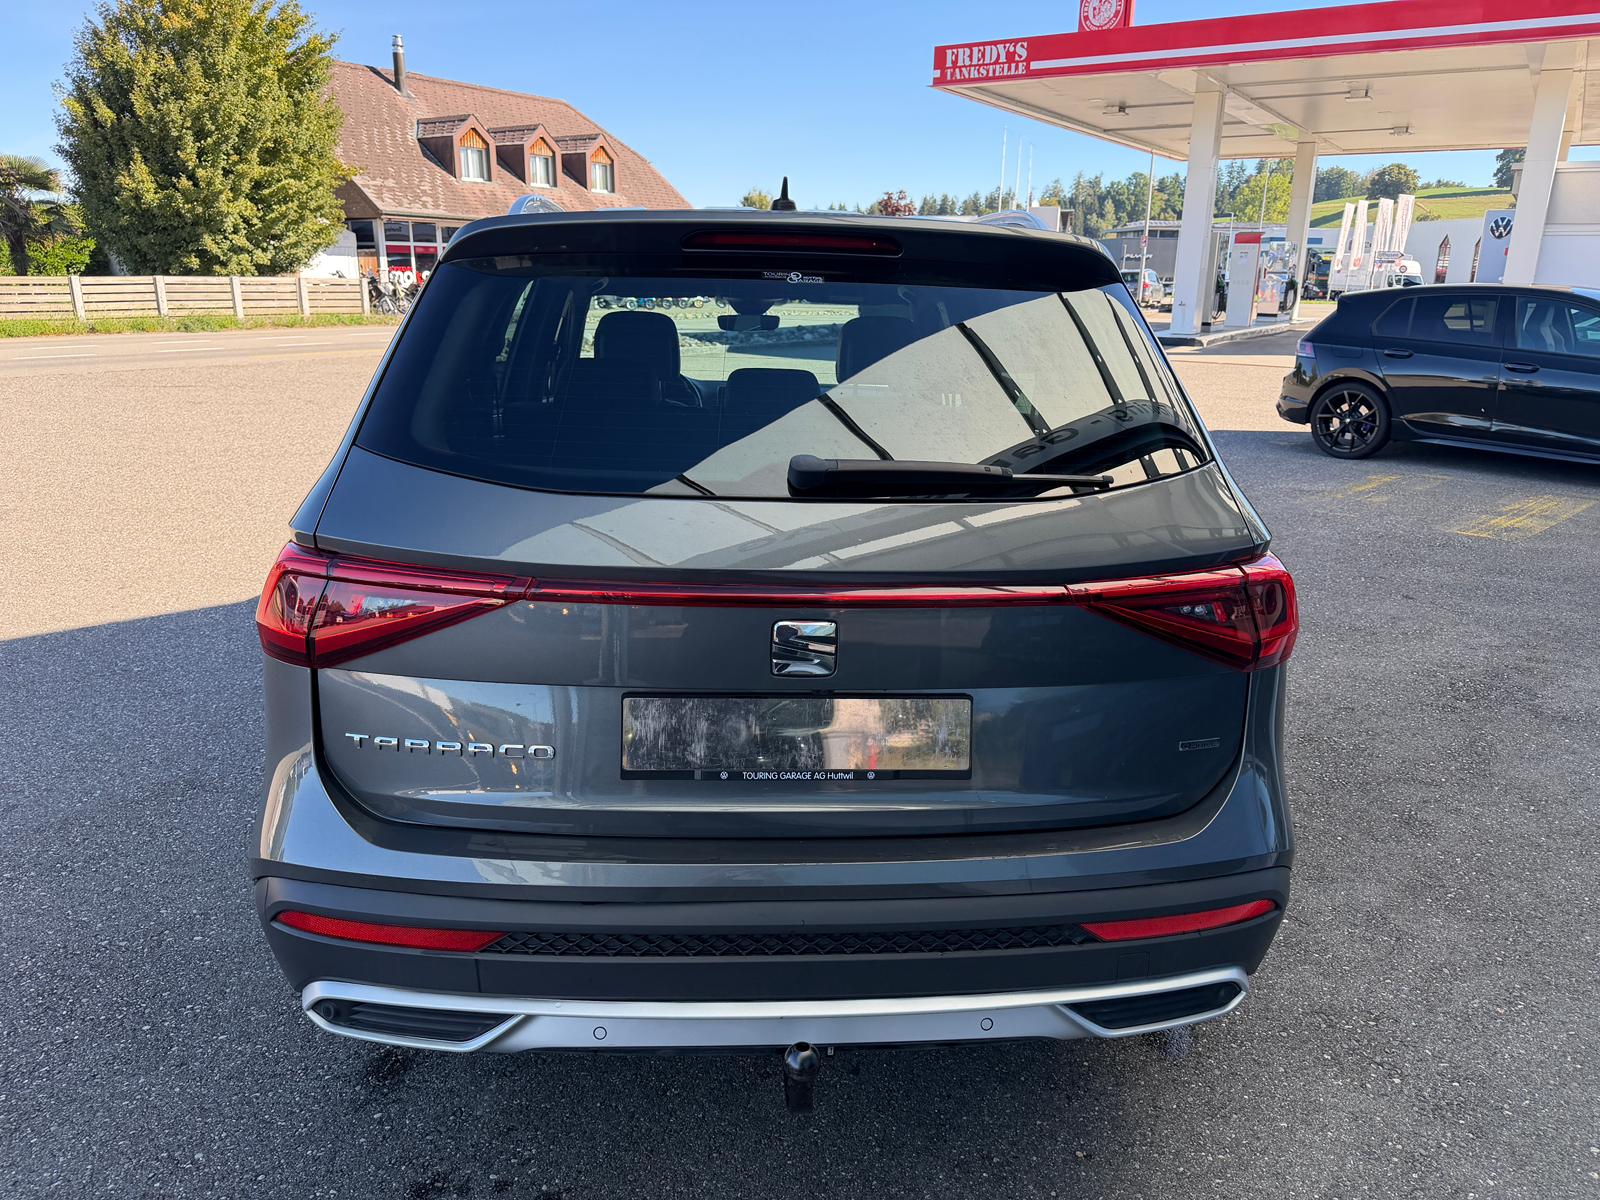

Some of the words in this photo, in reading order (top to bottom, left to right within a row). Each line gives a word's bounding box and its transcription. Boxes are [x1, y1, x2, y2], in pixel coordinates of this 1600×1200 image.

[945, 62, 1027, 80] TANKSTELLE
[345, 732, 555, 760] TARRACO
[743, 771, 778, 781] TOURING
[780, 771, 812, 781] GARAGE
[813, 771, 826, 781] AG
[828, 771, 854, 781] Huttwil
